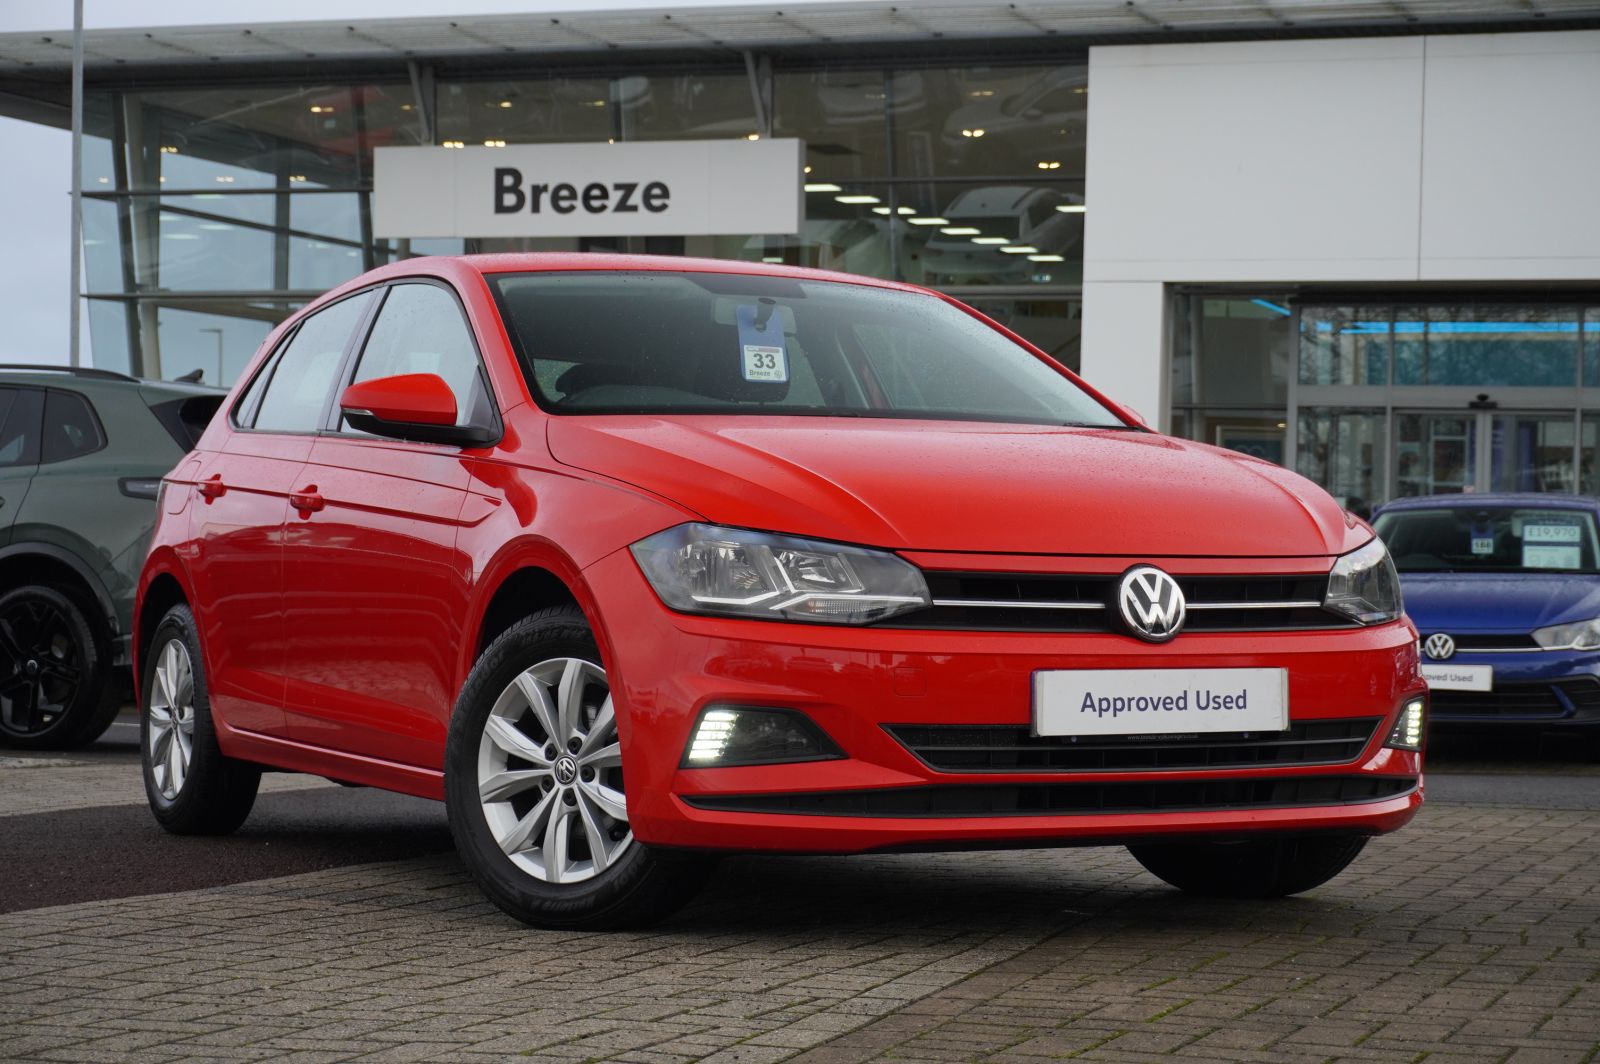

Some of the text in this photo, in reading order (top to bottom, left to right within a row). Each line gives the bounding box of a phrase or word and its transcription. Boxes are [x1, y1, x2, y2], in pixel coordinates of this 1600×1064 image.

[494, 167, 670, 214] Breeze
[753, 353, 776, 369] 33
[1450, 674, 1474, 682] Used
[1080, 689, 1247, 718] Approved Used
